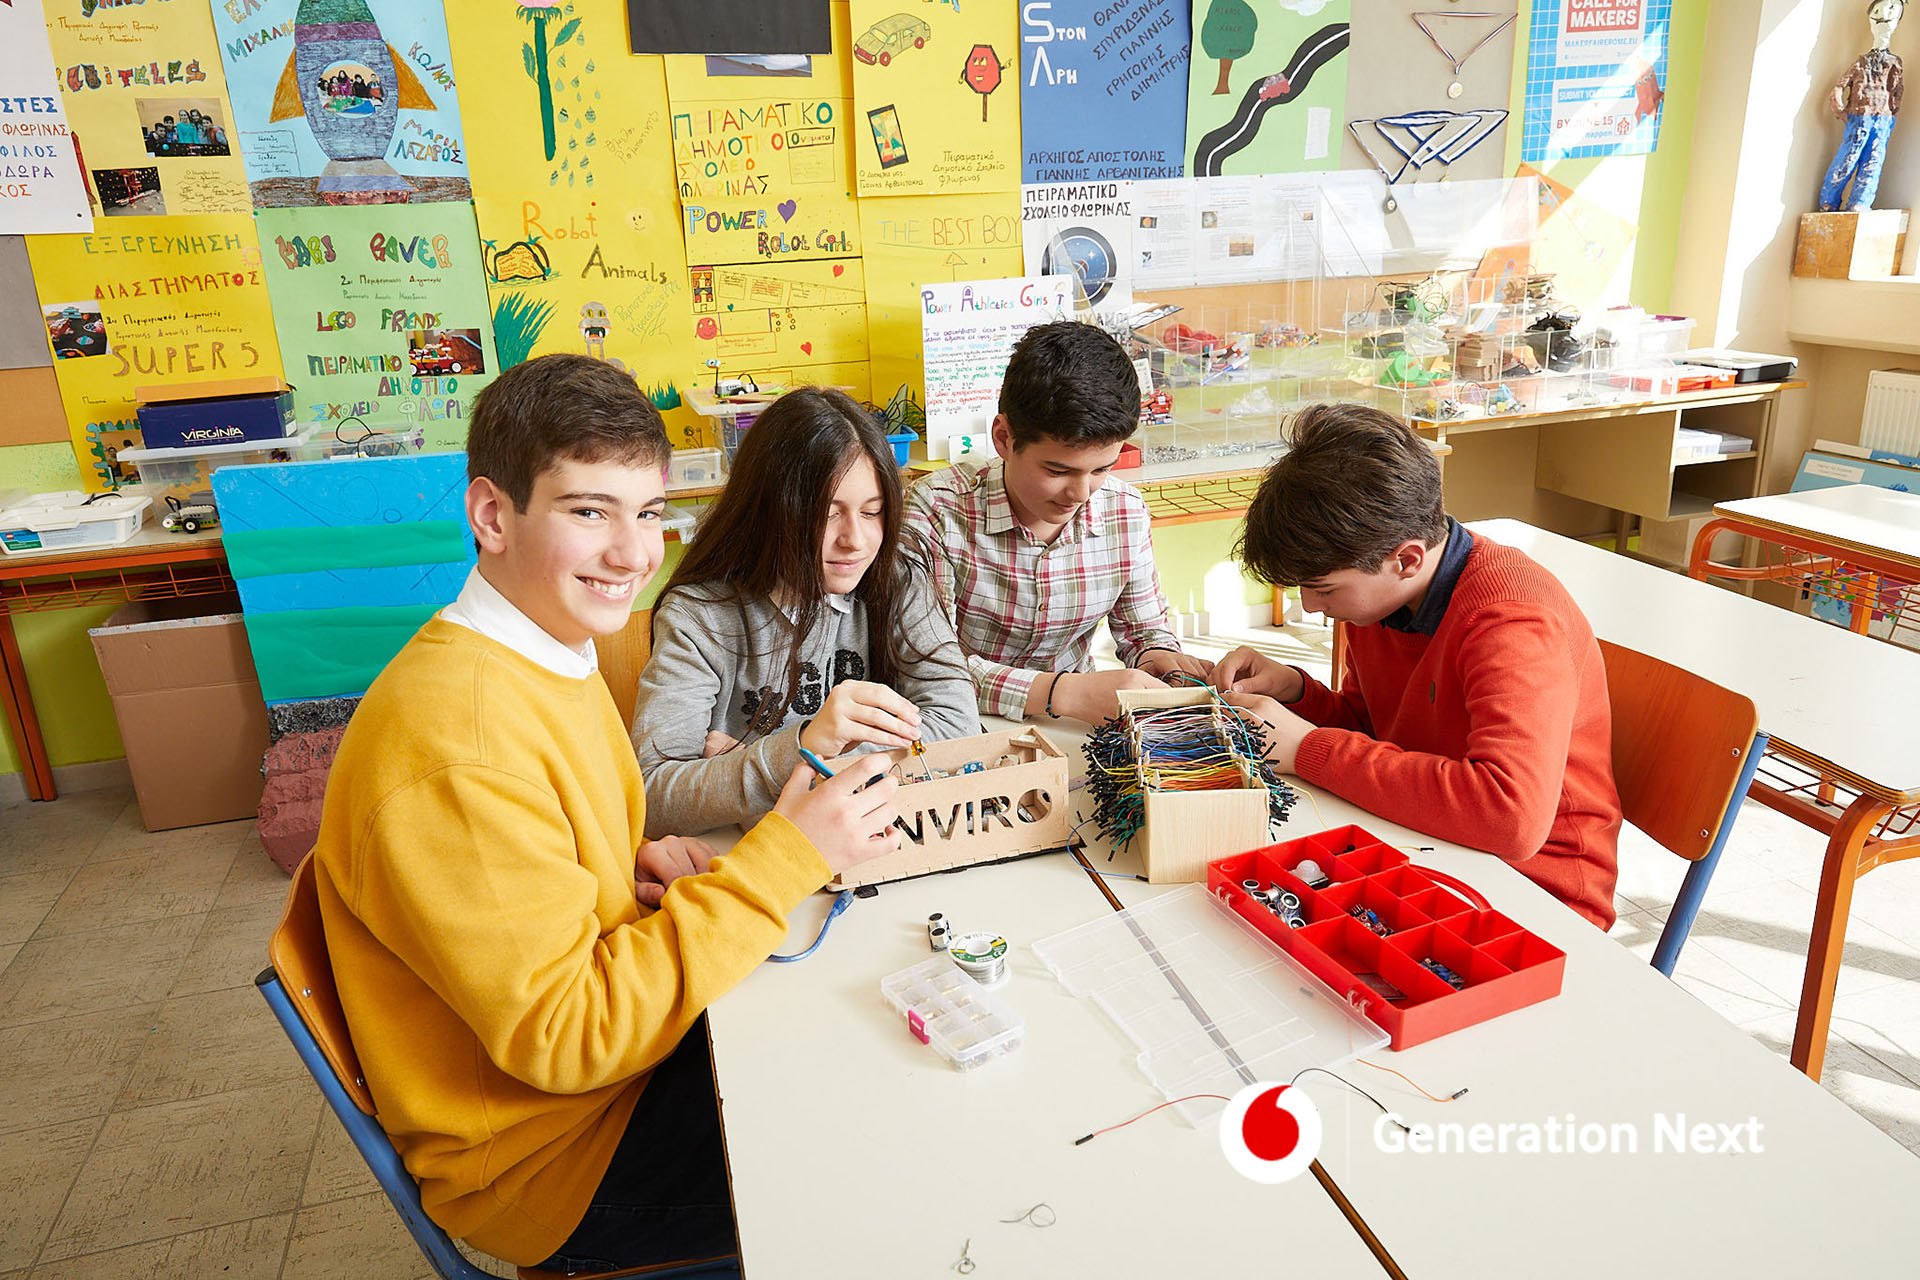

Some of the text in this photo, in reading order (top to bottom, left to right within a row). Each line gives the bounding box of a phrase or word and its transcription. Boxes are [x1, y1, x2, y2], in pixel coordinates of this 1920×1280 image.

[1093, 0, 1130, 27] ΘΑΝ
[1570, 8, 1637, 28] MAKERS
[1119, 9, 1175, 62] ΓΙΑΝΝΗΣ
[1106, 43, 1166, 97] ΓΡΗΓΟΡΗΣ
[2, 122, 69, 137] ΦΛΩΡΙΝΑΣ
[1602, 115, 1614, 126] 15
[393, 139, 464, 164] ΛΑΖΑΡΟΣ
[1028, 150, 1167, 165] ΑΡΧΗΓΟΣ ΑΠΟΣΤΟΛΗΣ
[0, 164, 55, 178] ΔΩΡΑ
[1036, 167, 1091, 181] ΓΙΑΝΝΗΣ
[1026, 183, 1118, 203] ΠΕΙΡΑΜΑΤΙΚΟ
[685, 205, 769, 235] POWER
[1070, 201, 1132, 218] ΦΛΩΡΙΝΑΣ
[757, 228, 853, 259] Robot Girls
[876, 219, 921, 244] THE
[932, 217, 975, 246] BEST
[82, 234, 243, 256] ΕΞΕΡΕΥΝΗΣΗ
[580, 243, 668, 285] Animals
[94, 270, 261, 300] ΔΙΑΣΤΗΜΑΤΟΣ
[921, 289, 953, 315] Power
[1020, 283, 1049, 307] Girls
[316, 308, 443, 333] LEGO FRIENDS
[112, 341, 260, 378] SUPER 5
[307, 354, 403, 377] ΠΕΙΡΑΜΑΤΙΚΟ
[309, 399, 380, 422] ΣΧΟΛΕΙΟ
[180, 424, 245, 441] VIRGINIA
